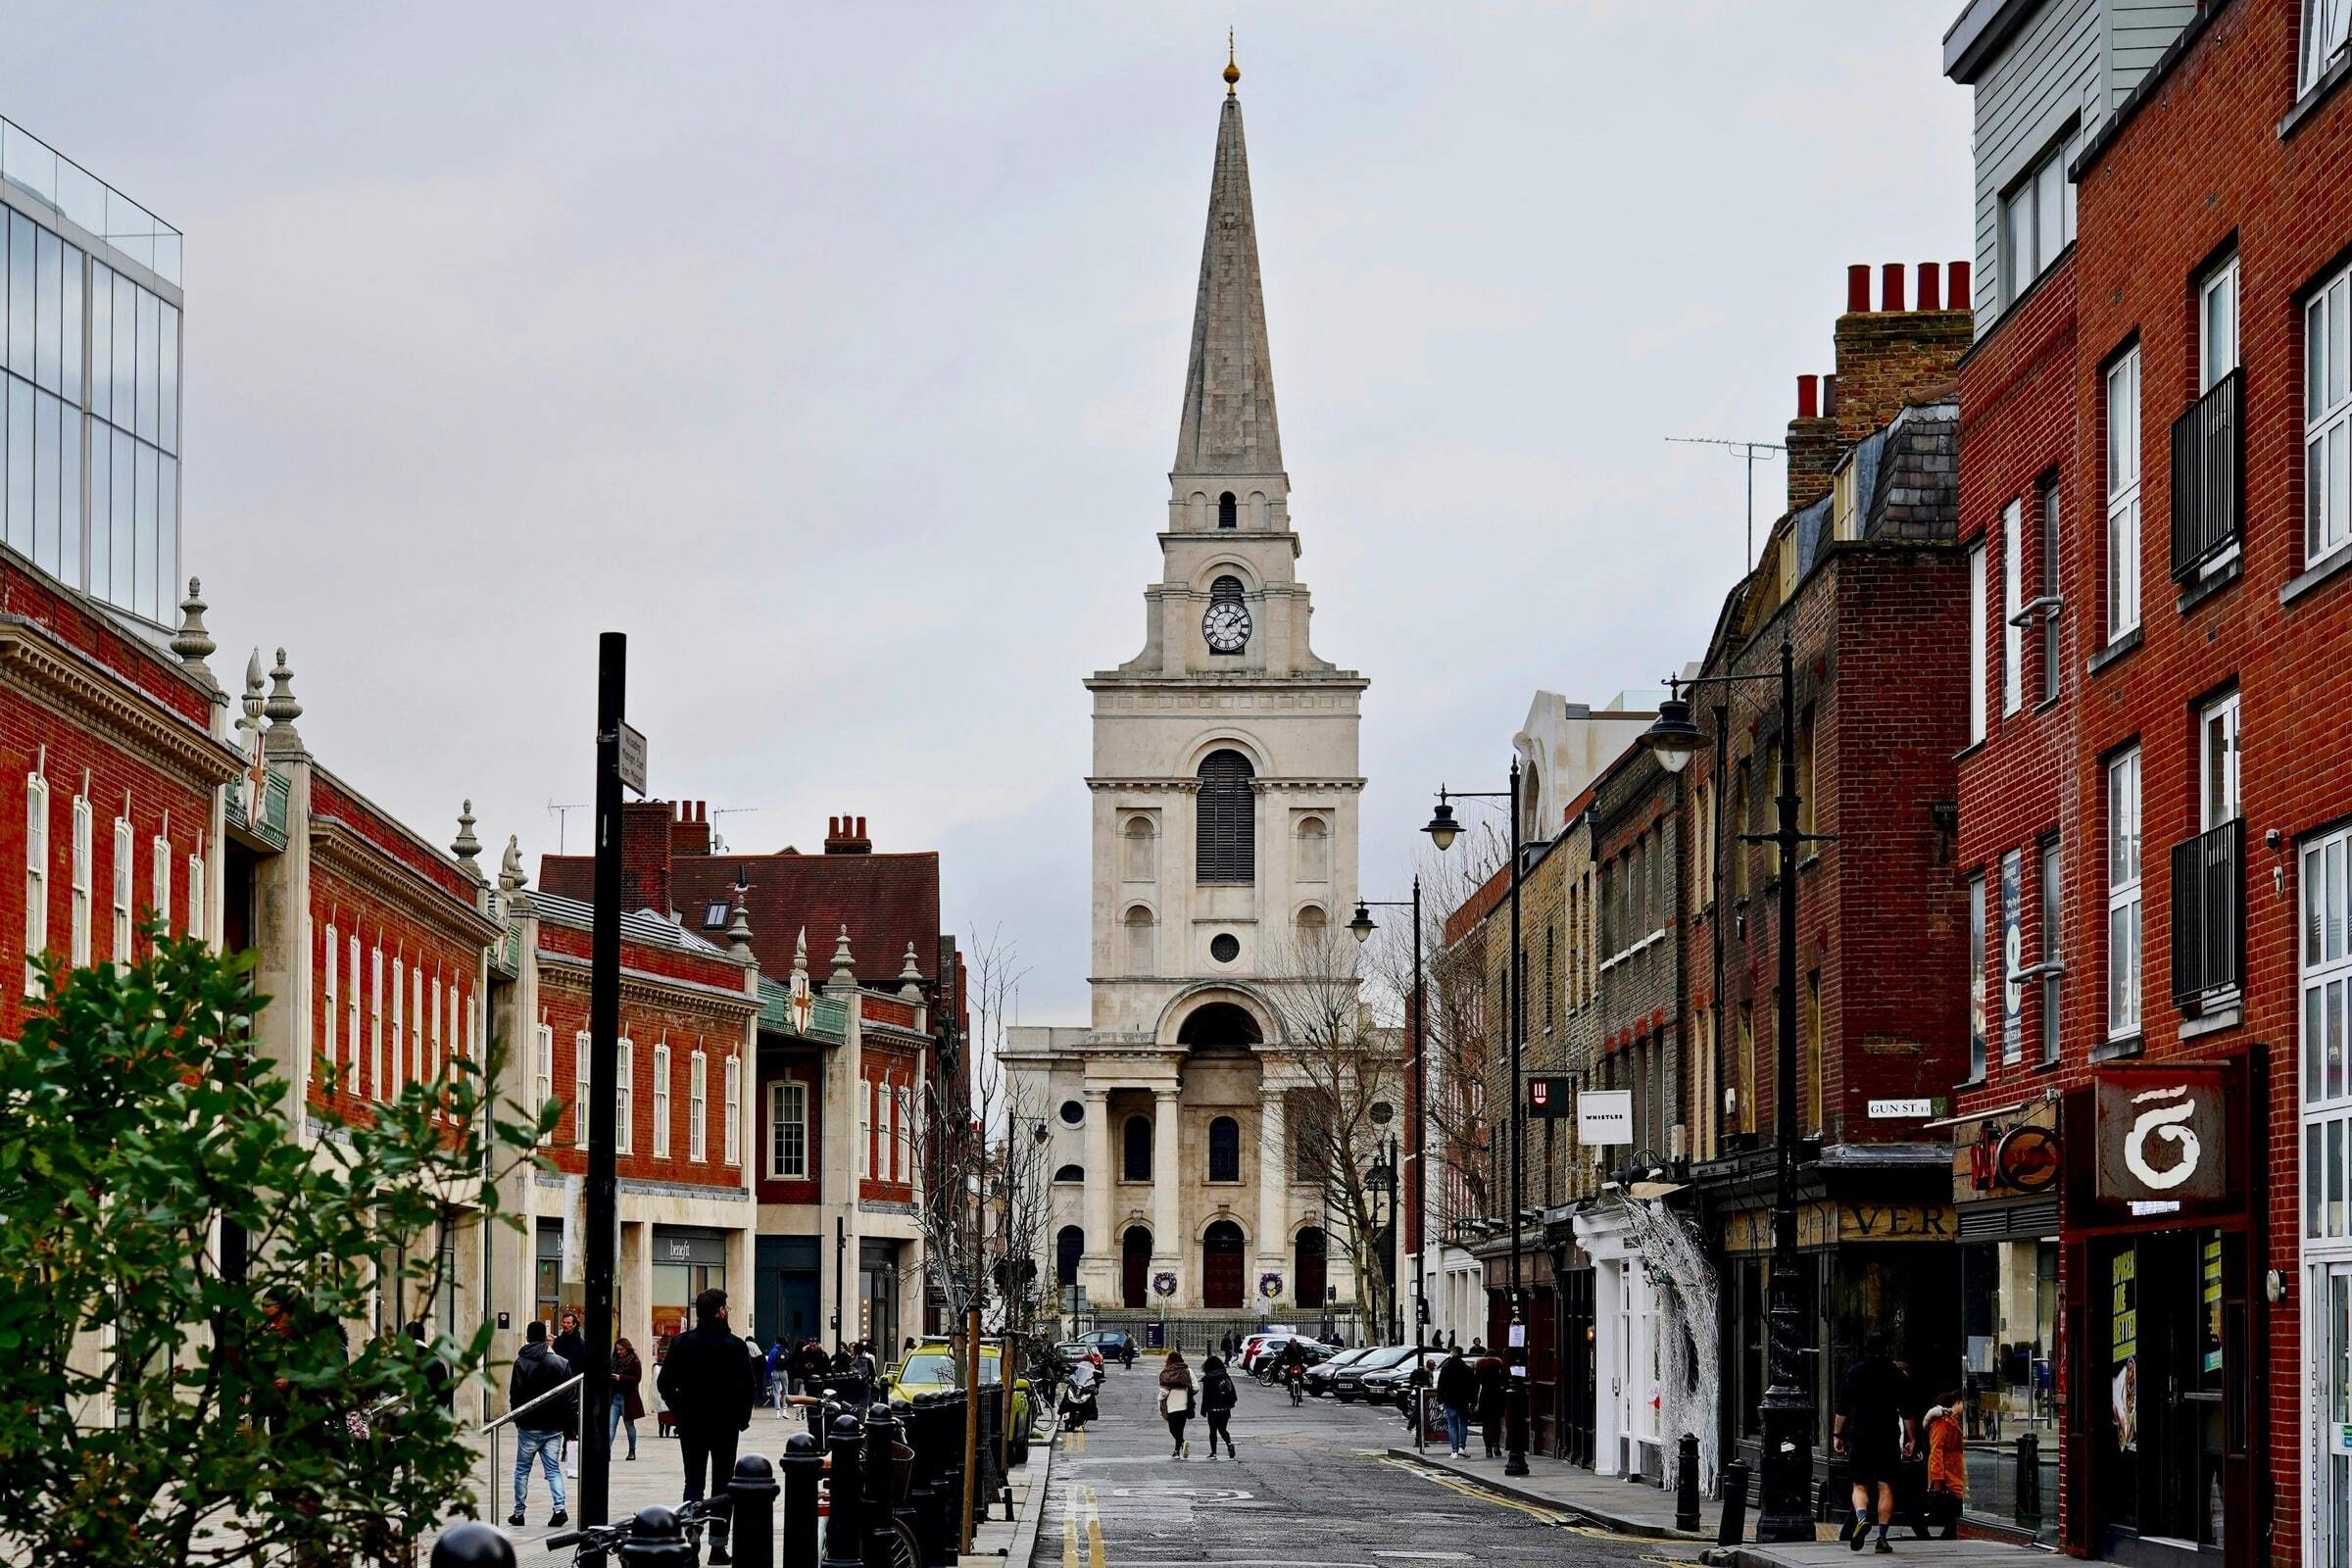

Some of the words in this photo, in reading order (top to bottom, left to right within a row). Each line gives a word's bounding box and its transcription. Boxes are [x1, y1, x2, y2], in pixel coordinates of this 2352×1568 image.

[1871, 1104, 1898, 1113] GUN
[1848, 1205, 1948, 1236] VER
[669, 1239, 691, 1260] benefit
